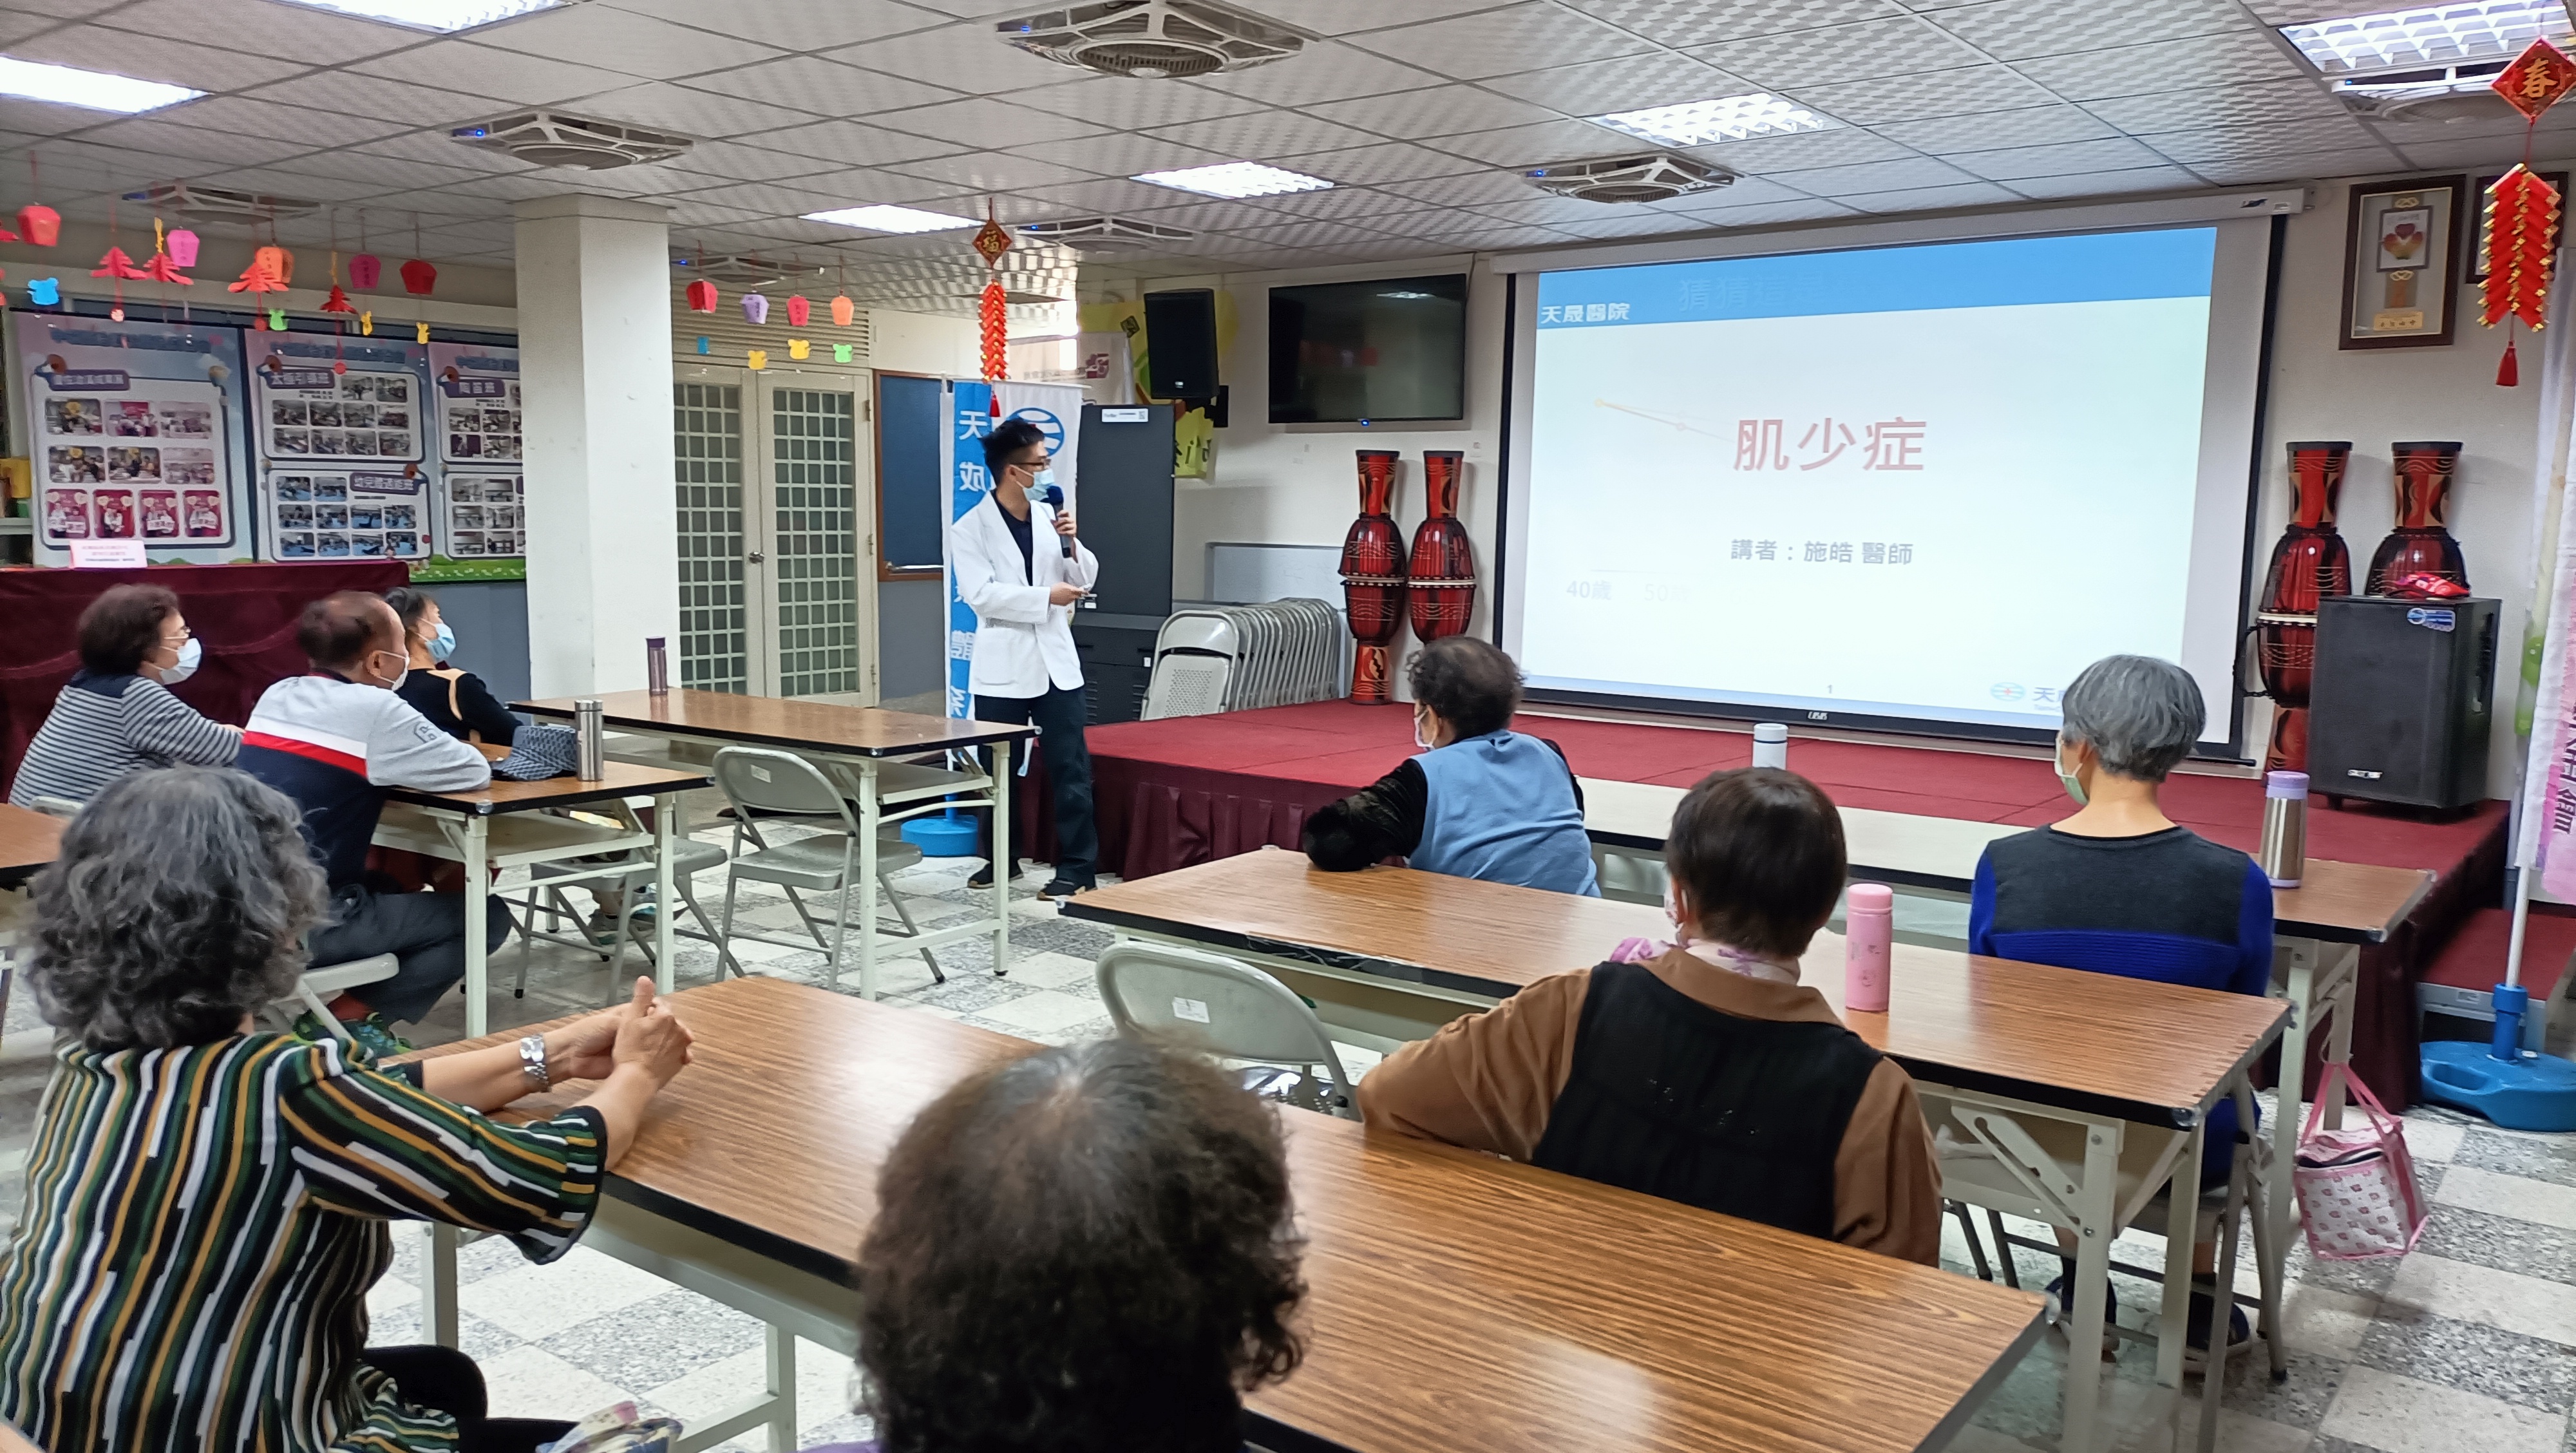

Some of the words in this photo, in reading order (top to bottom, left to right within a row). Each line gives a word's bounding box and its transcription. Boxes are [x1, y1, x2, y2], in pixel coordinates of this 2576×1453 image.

[2521, 59, 2557, 98] 春
[983, 230, 999, 252] 福
[1542, 302, 1629, 324] 天晟醫院
[1734, 417, 1926, 471] 肌少症
[1861, 542, 1913, 565] 醫師
[1566, 580, 1612, 600] 40歲
[1827, 685, 1833, 694] 1
[2033, 687, 2065, 702] 天
